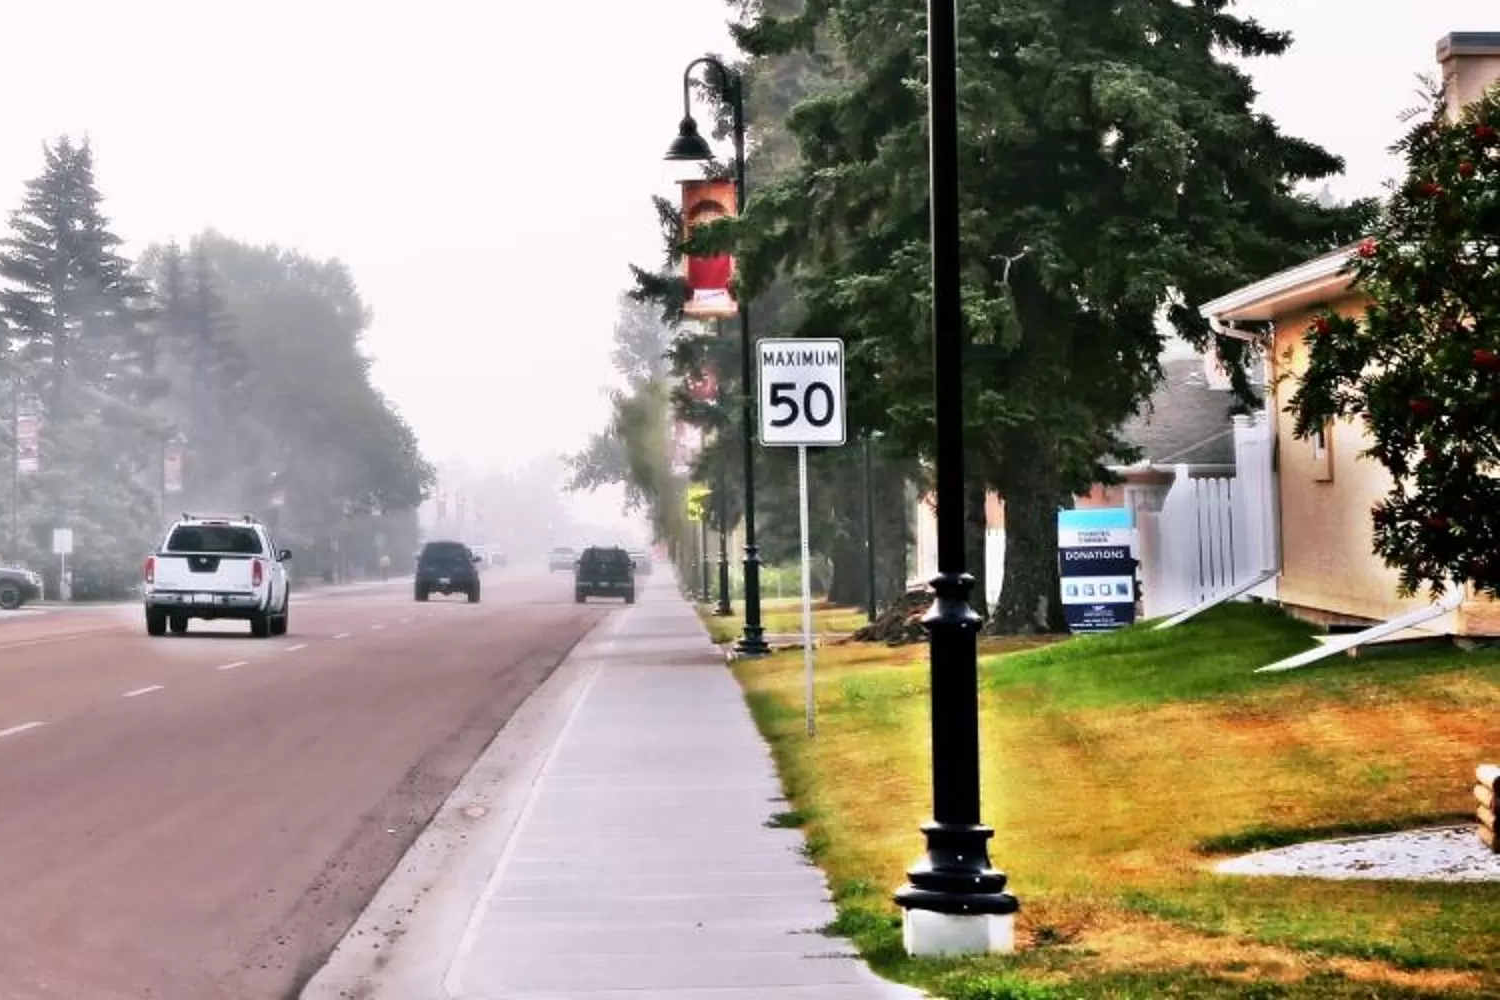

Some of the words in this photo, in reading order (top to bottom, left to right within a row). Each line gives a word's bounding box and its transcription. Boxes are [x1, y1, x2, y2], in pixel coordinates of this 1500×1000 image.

[763, 350, 839, 367] MAXIMUM
[769, 381, 835, 429] 50
[1065, 549, 1125, 561] DONATIONS
